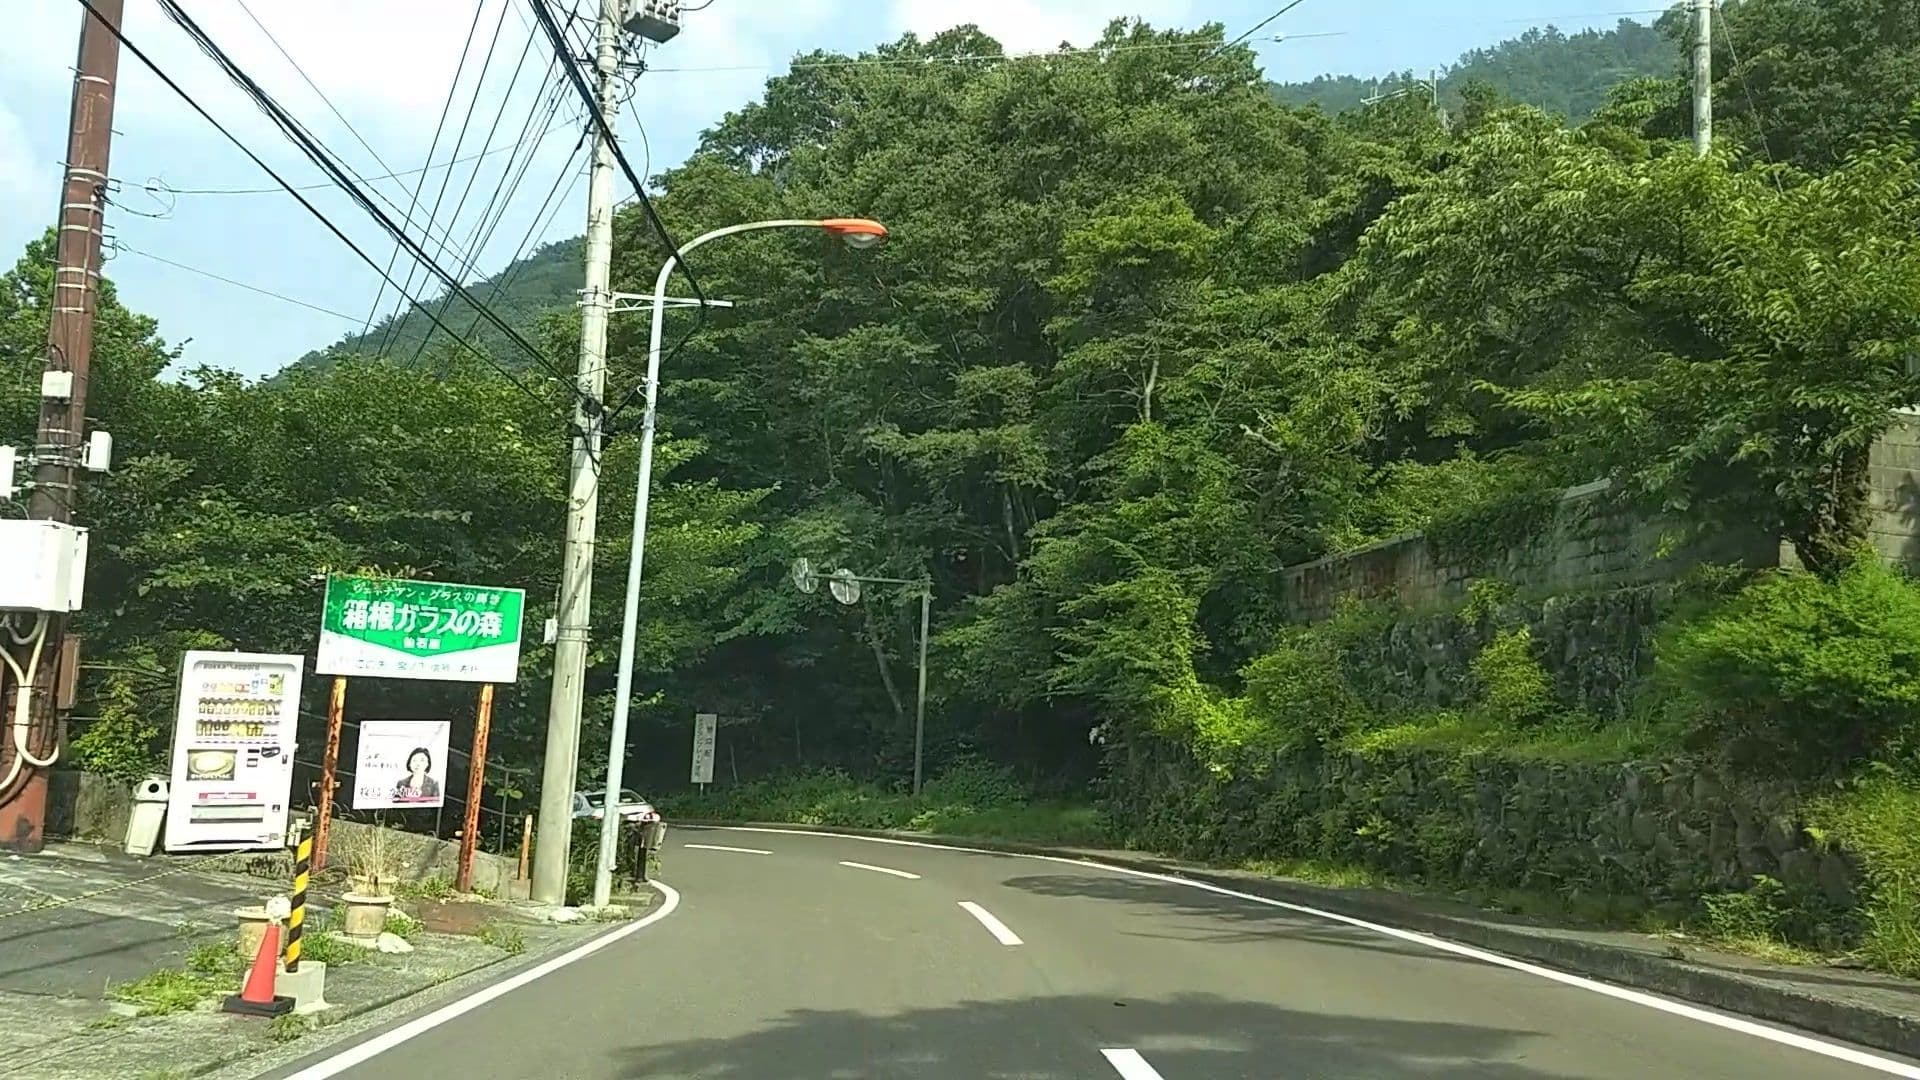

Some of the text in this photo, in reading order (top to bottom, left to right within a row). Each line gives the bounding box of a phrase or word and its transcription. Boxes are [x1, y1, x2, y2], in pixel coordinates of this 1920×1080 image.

[342, 599, 504, 638] 箱根ガラスの森
